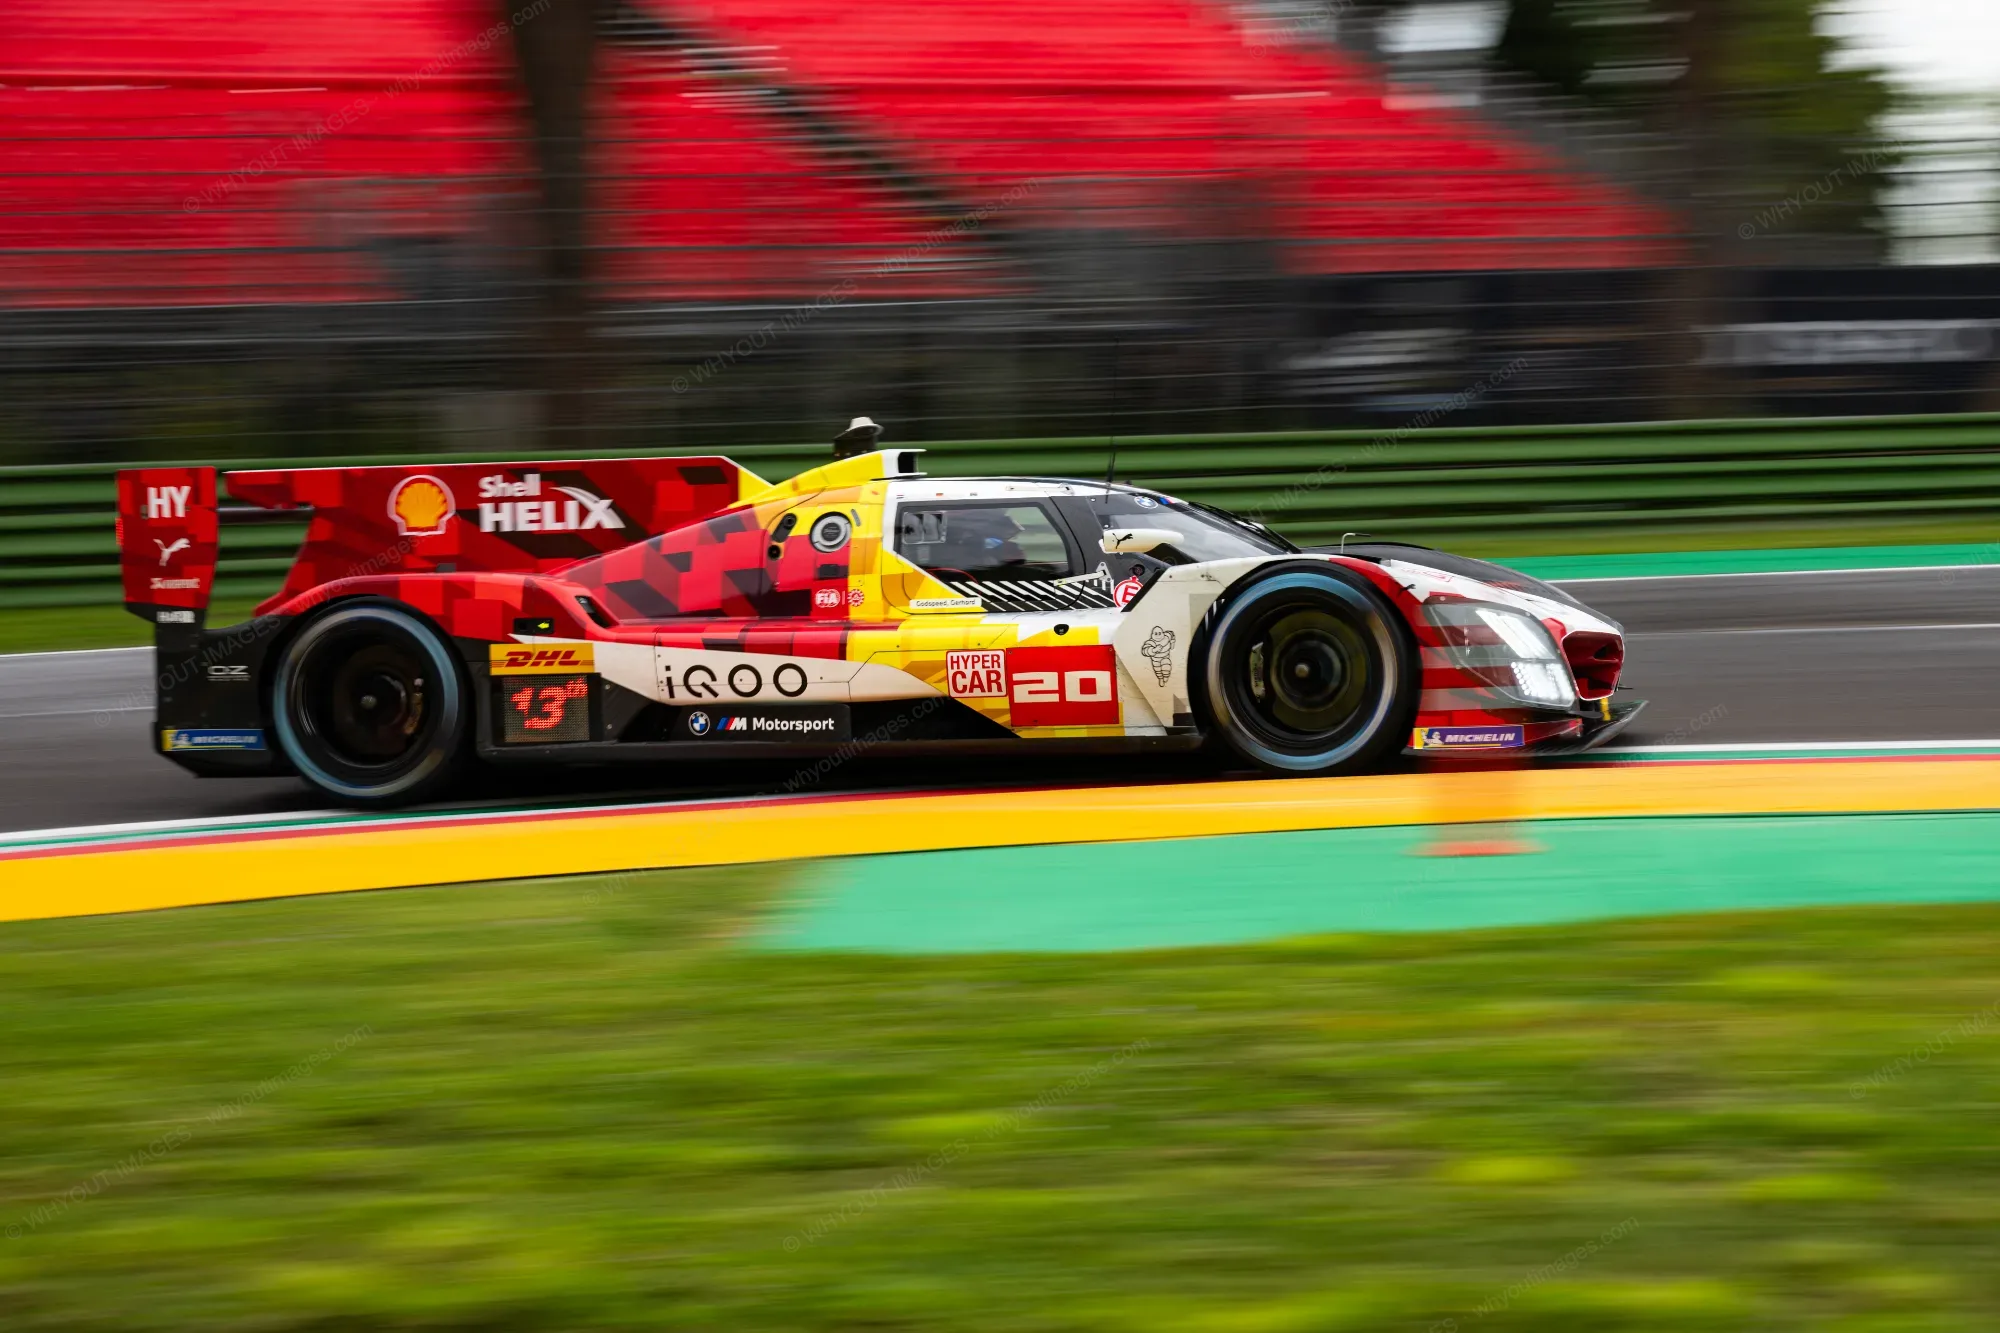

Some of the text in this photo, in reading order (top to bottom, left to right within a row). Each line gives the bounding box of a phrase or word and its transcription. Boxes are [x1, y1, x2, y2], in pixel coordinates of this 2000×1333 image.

[478, 473, 541, 498] Shell
[147, 486, 191, 518] HY
[477, 487, 626, 532] HELIX
[207, 665, 249, 675] OZ
[504, 650, 582, 668] DHL
[950, 653, 1001, 670] HYPER
[665, 662, 808, 699] iQOO
[951, 669, 1004, 694] CAR
[1012, 670, 1112, 704] 20
[752, 717, 835, 733] Motorsport
[1444, 732, 1516, 743] MICHELIN
